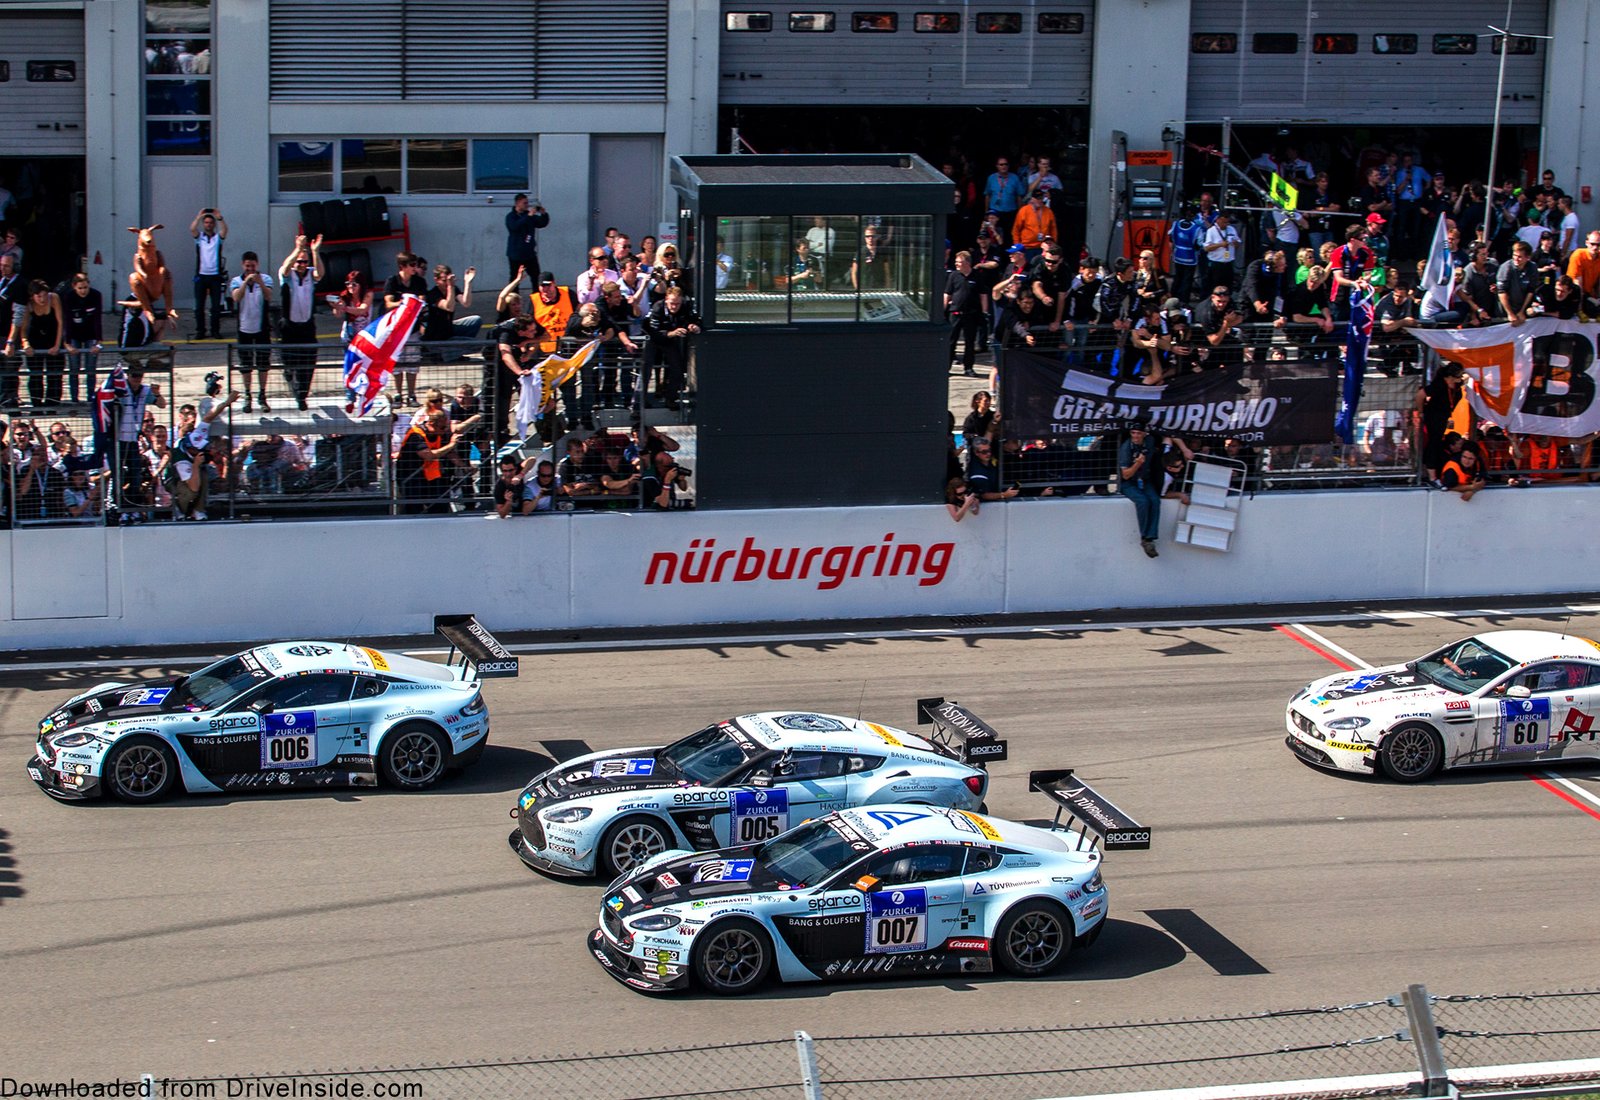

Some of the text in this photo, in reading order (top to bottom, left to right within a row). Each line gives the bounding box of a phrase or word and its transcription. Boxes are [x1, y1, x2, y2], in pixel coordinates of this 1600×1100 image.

[1053, 394, 1139, 420] GRAN
[1148, 397, 1278, 432] TURISMO
[1050, 423, 1080, 433] THE
[1083, 422, 1120, 432] REAL
[644, 532, 956, 590] nürburgring
[478, 661, 518, 672] sparco
[1514, 713, 1542, 721] ZURICH
[210, 716, 257, 731] sparco
[275, 728, 307, 736] ZURICH
[1514, 721, 1538, 744] 60
[194, 734, 258, 745] BANG & OLUFSEN
[271, 736, 309, 762] 006
[970, 745, 1002, 755] sparco
[890, 752, 910, 760] BANG
[917, 756, 946, 767] OLUFSEN
[569, 791, 591, 799] BANG
[600, 785, 637, 793] OLUFSEN
[674, 791, 728, 806] sparco
[617, 803, 659, 811] FALKEN
[746, 806, 778, 815] ZURICH
[741, 816, 779, 842] 005
[1107, 831, 1150, 844] sparco
[808, 895, 861, 911] sparco
[710, 908, 755, 917] FALKEN
[882, 906, 917, 916] ZURICH
[789, 916, 861, 927] BANG & OLUFSEN
[680, 927, 696, 936] KW
[877, 917, 918, 945] 007
[651, 936, 683, 945] YOKOHAMA
[949, 940, 985, 949] Carrera
